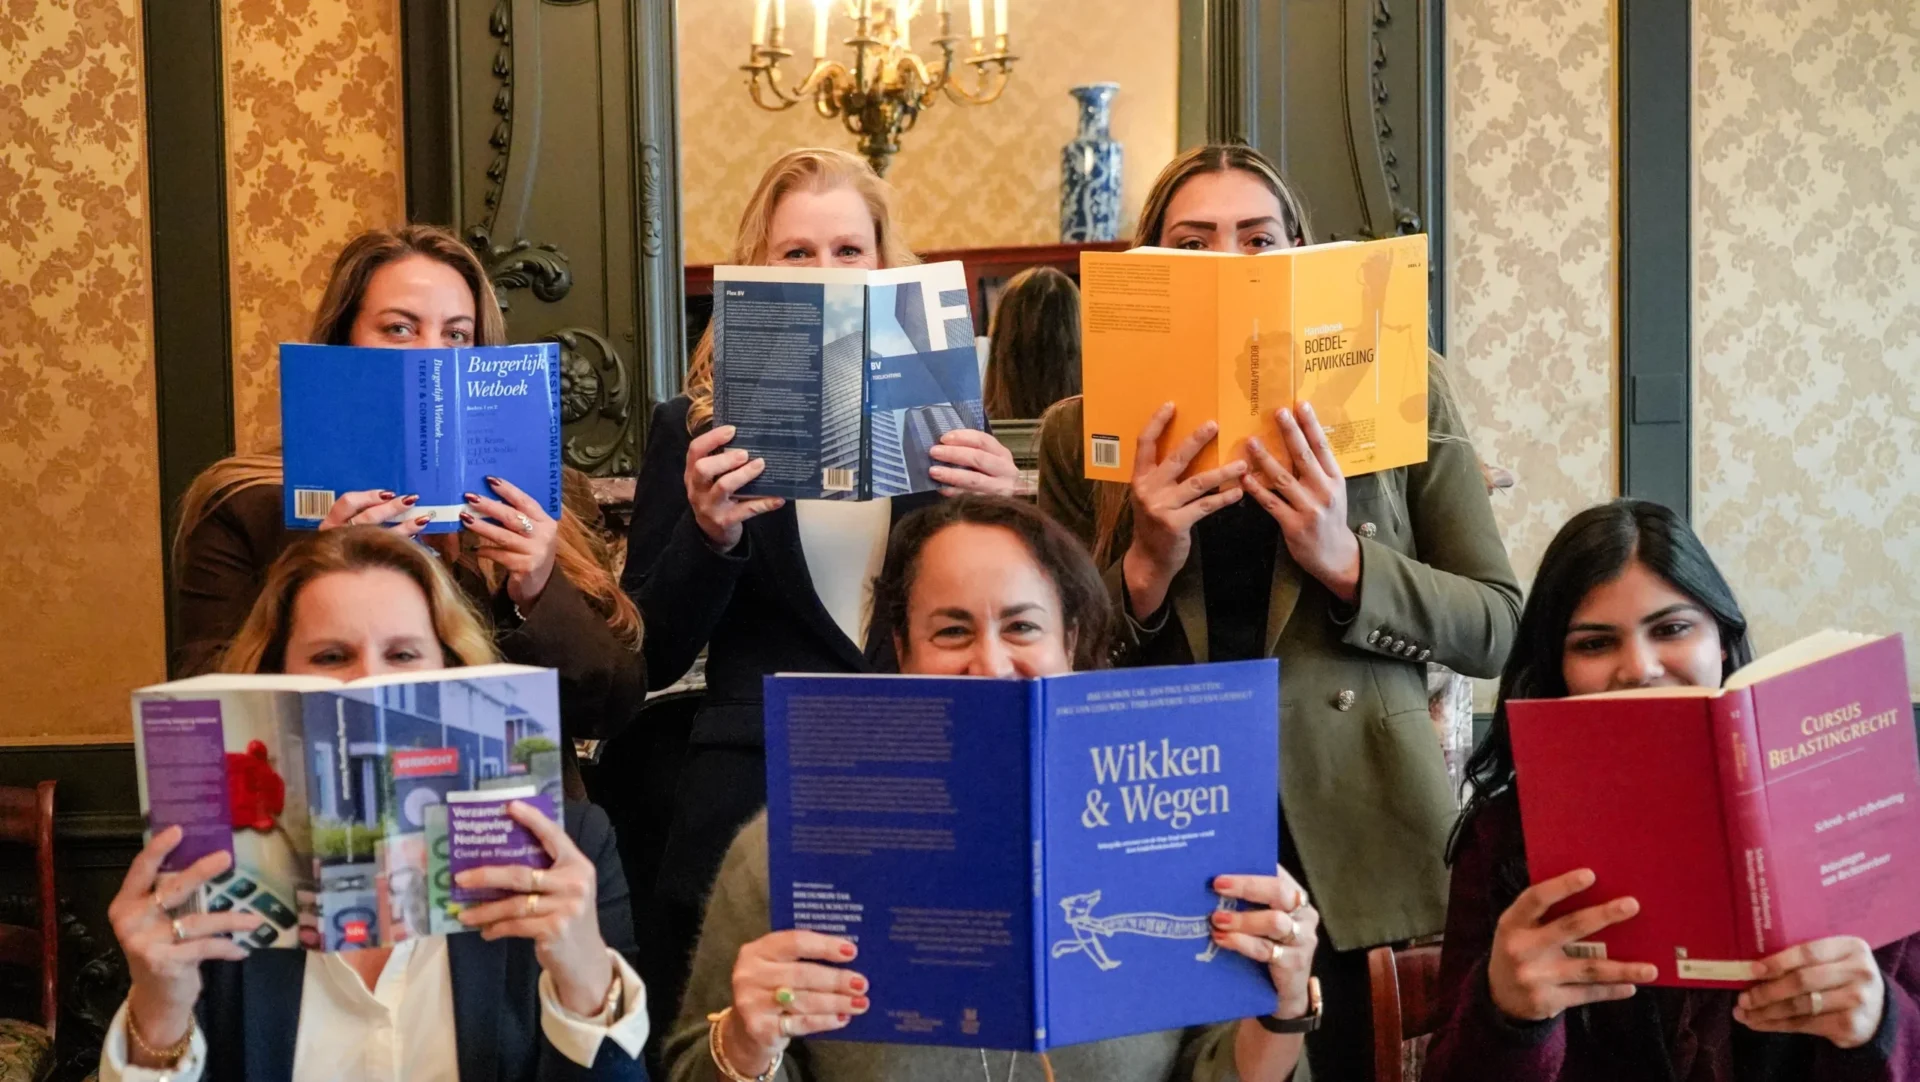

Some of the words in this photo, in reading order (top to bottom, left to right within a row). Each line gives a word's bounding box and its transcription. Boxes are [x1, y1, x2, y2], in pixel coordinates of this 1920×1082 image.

[1304, 335, 1348, 355] BOEDEL-
[1304, 348, 1374, 373] AFWIKKELING
[418, 360, 427, 389] TEKST
[432, 358, 443, 402] Burgerlijk
[467, 353, 546, 378] Burgerlijk
[548, 353, 558, 396] TEKST
[870, 361, 882, 370] BV
[1250, 345, 1260, 416] BOEDELAFWIKKELING
[419, 392, 427, 400] &
[466, 379, 529, 398] Wetboek
[419, 402, 428, 471] COMMENTAAR
[434, 404, 444, 438] Wetboek
[549, 415, 559, 512] COMMENTAAR
[1801, 701, 1863, 736] CURSUS
[1768, 708, 1898, 770] BELASTINGRECHT
[1089, 738, 1221, 785] Wikken
[1081, 788, 1111, 829] &
[1119, 783, 1230, 830] Wegen
